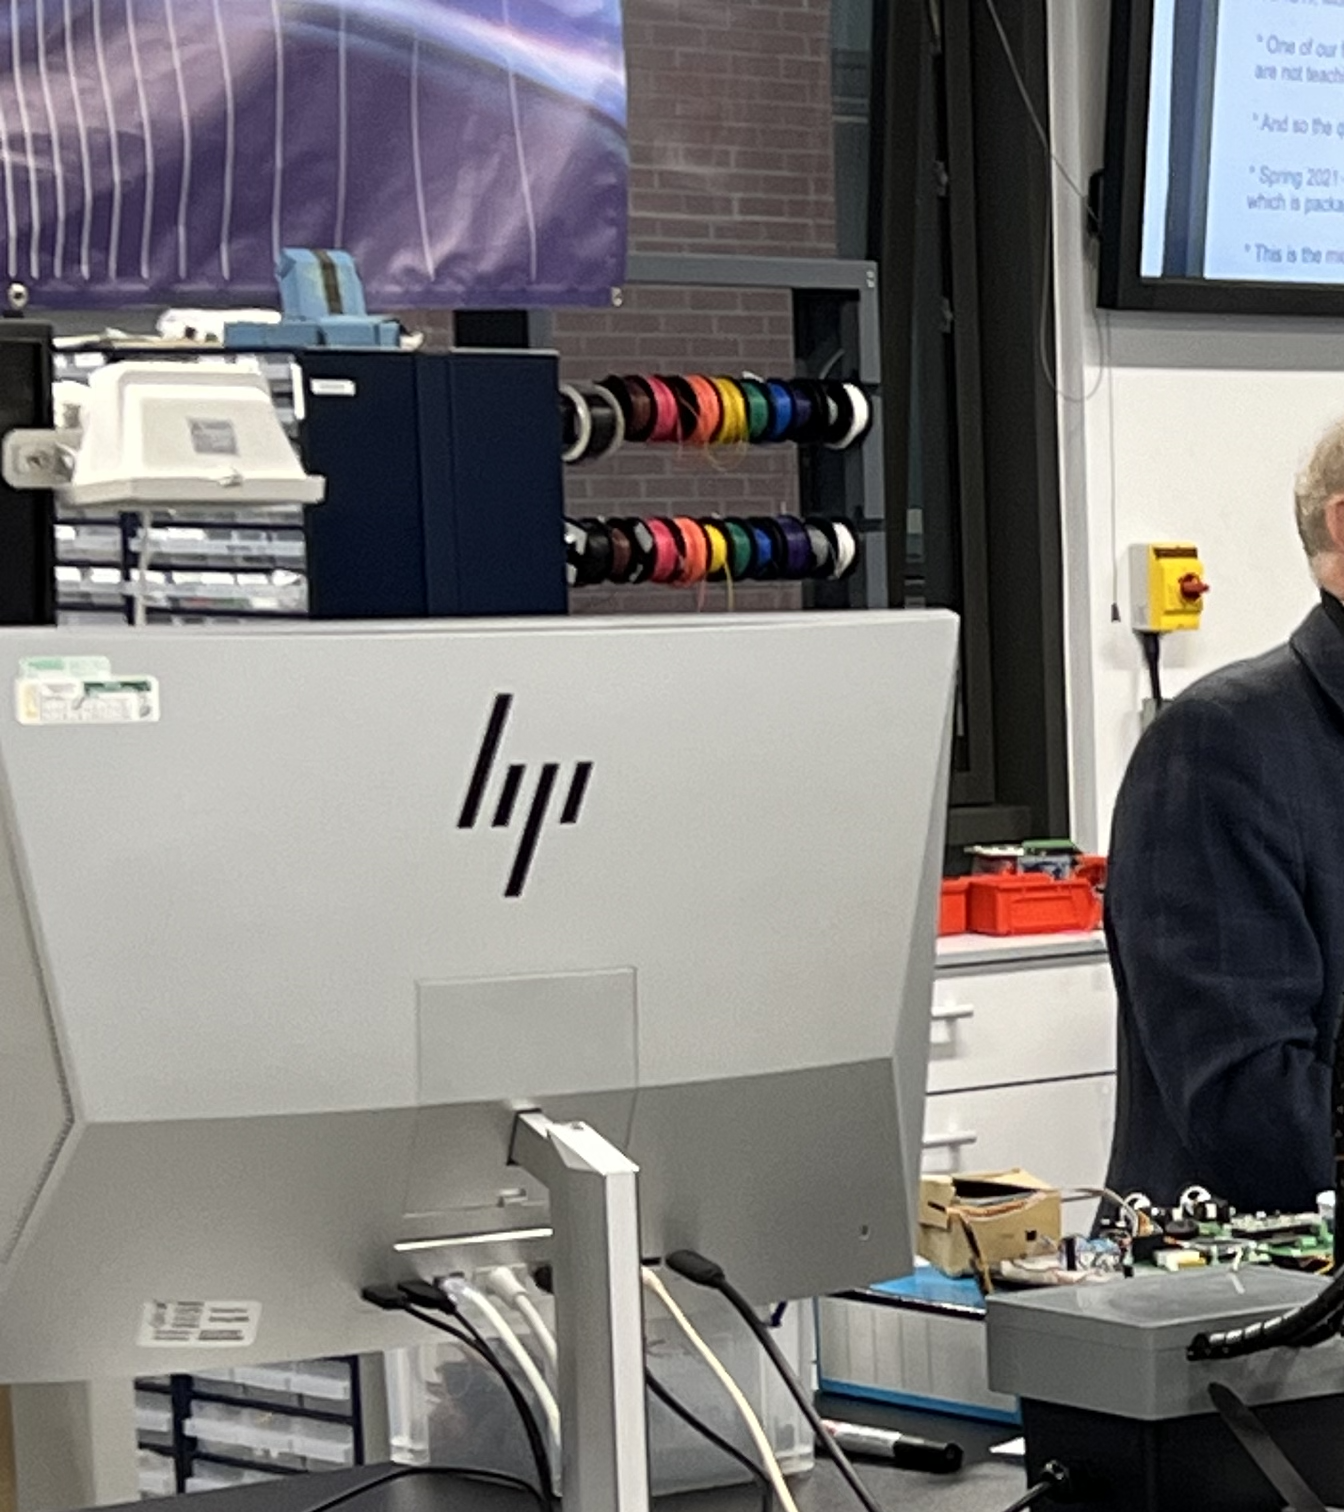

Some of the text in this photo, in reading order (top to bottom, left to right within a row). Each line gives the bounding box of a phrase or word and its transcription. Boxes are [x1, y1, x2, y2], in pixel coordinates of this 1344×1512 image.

[1266, 34, 1296, 55] One
[1300, 38, 1313, 57] of
[1315, 42, 1338, 58] our
[1254, 65, 1277, 80] are
[1281, 67, 1303, 82] not
[1260, 113, 1288, 133] And
[1292, 119, 1309, 134] so
[1312, 118, 1333, 137] the
[1259, 165, 1303, 190] Spring
[1306, 168, 1339, 187] 2021
[1247, 193, 1286, 211] which
[1290, 195, 1301, 211] is
[1255, 243, 1282, 263] This
[1287, 245, 1297, 263] is
[1301, 247, 1322, 265] the
